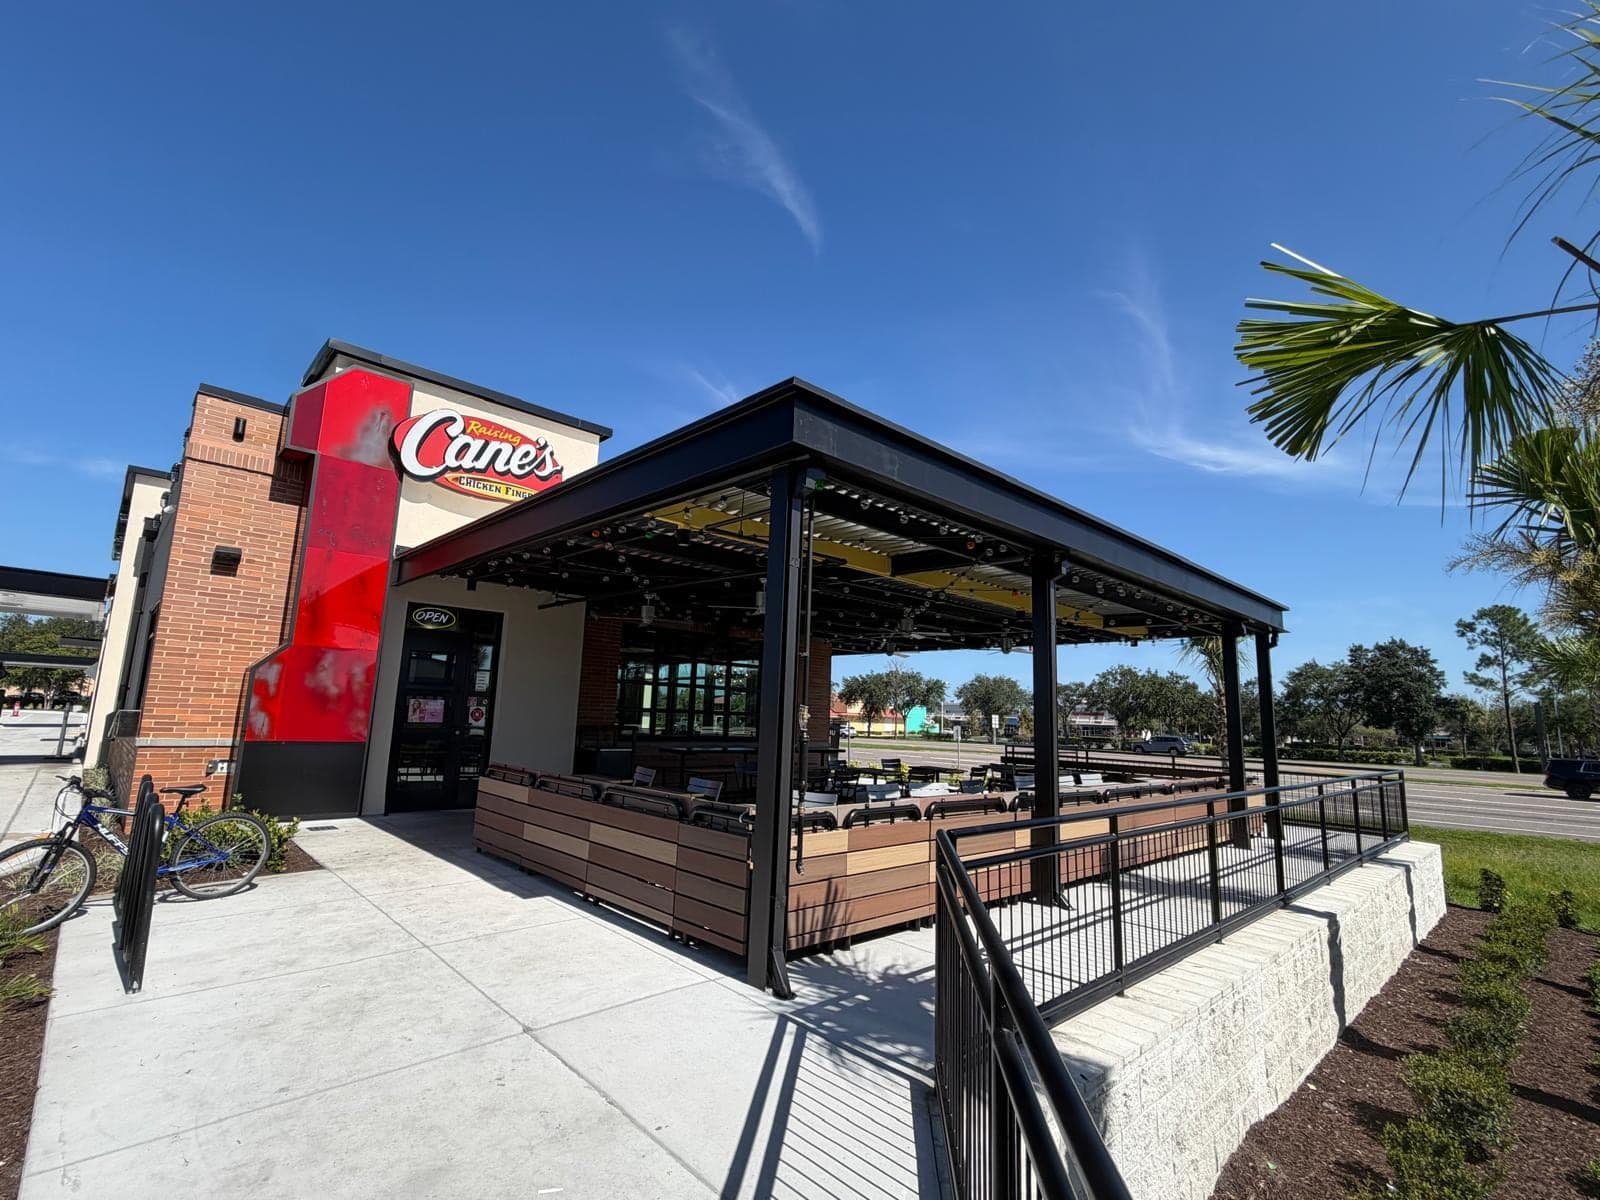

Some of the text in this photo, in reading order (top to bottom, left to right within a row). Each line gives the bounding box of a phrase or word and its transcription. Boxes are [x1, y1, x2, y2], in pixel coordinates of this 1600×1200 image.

[400, 408, 563, 478] Cane's
[466, 420, 521, 445] Raising
[458, 476, 502, 494] CHICKEN
[415, 610, 449, 624] OPEN
